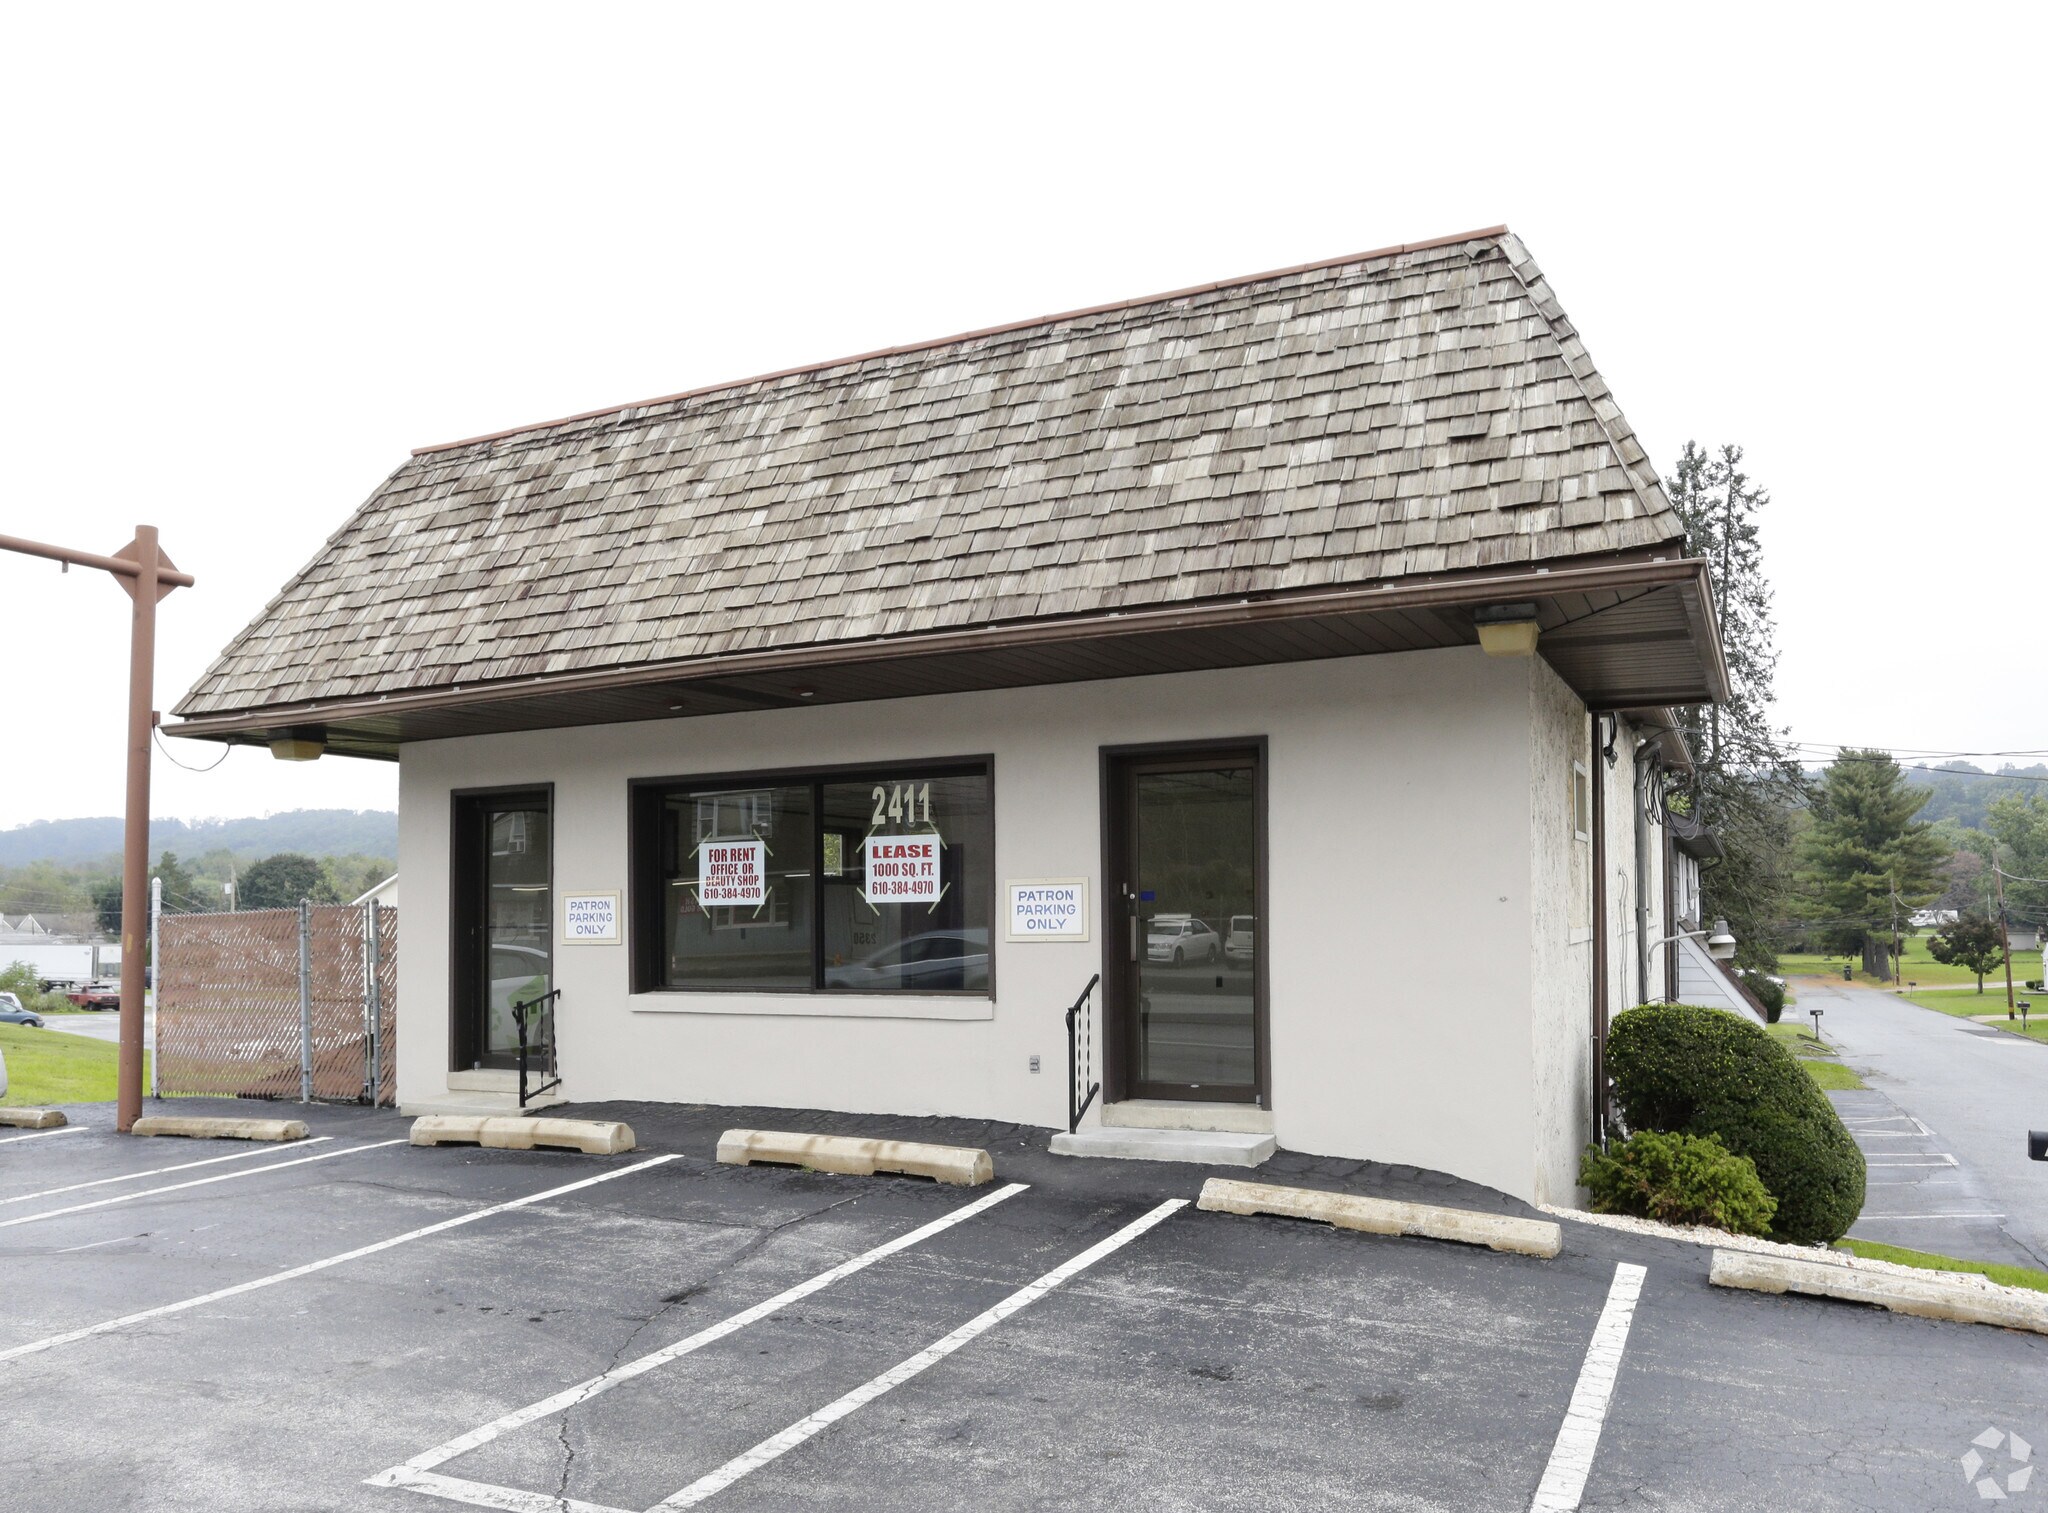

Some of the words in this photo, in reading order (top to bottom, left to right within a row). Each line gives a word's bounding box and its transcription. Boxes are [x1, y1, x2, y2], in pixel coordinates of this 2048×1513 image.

[871, 783, 929, 825] 2411
[708, 849, 728, 863] FOR
[730, 847, 756, 862] RENT
[872, 844, 933, 859] LEASE
[710, 863, 738, 875] OFFICE
[742, 863, 754, 874] OR
[872, 863, 899, 877] 1000
[902, 862, 919, 877] SQ.
[921, 862, 934, 876] FT.
[706, 875, 736, 887] BEAUTY
[737, 875, 759, 886] SHOP
[704, 887, 761, 899] 610-384-4970
[872, 881, 934, 895] 610-384-4970
[1018, 890, 1074, 902] PATRON
[570, 901, 610, 911] PATRON
[1016, 904, 1076, 916] PARKING
[569, 912, 613, 923] PARKING
[576, 925, 606, 935] ONLY
[1026, 918, 1067, 930] ONLY
